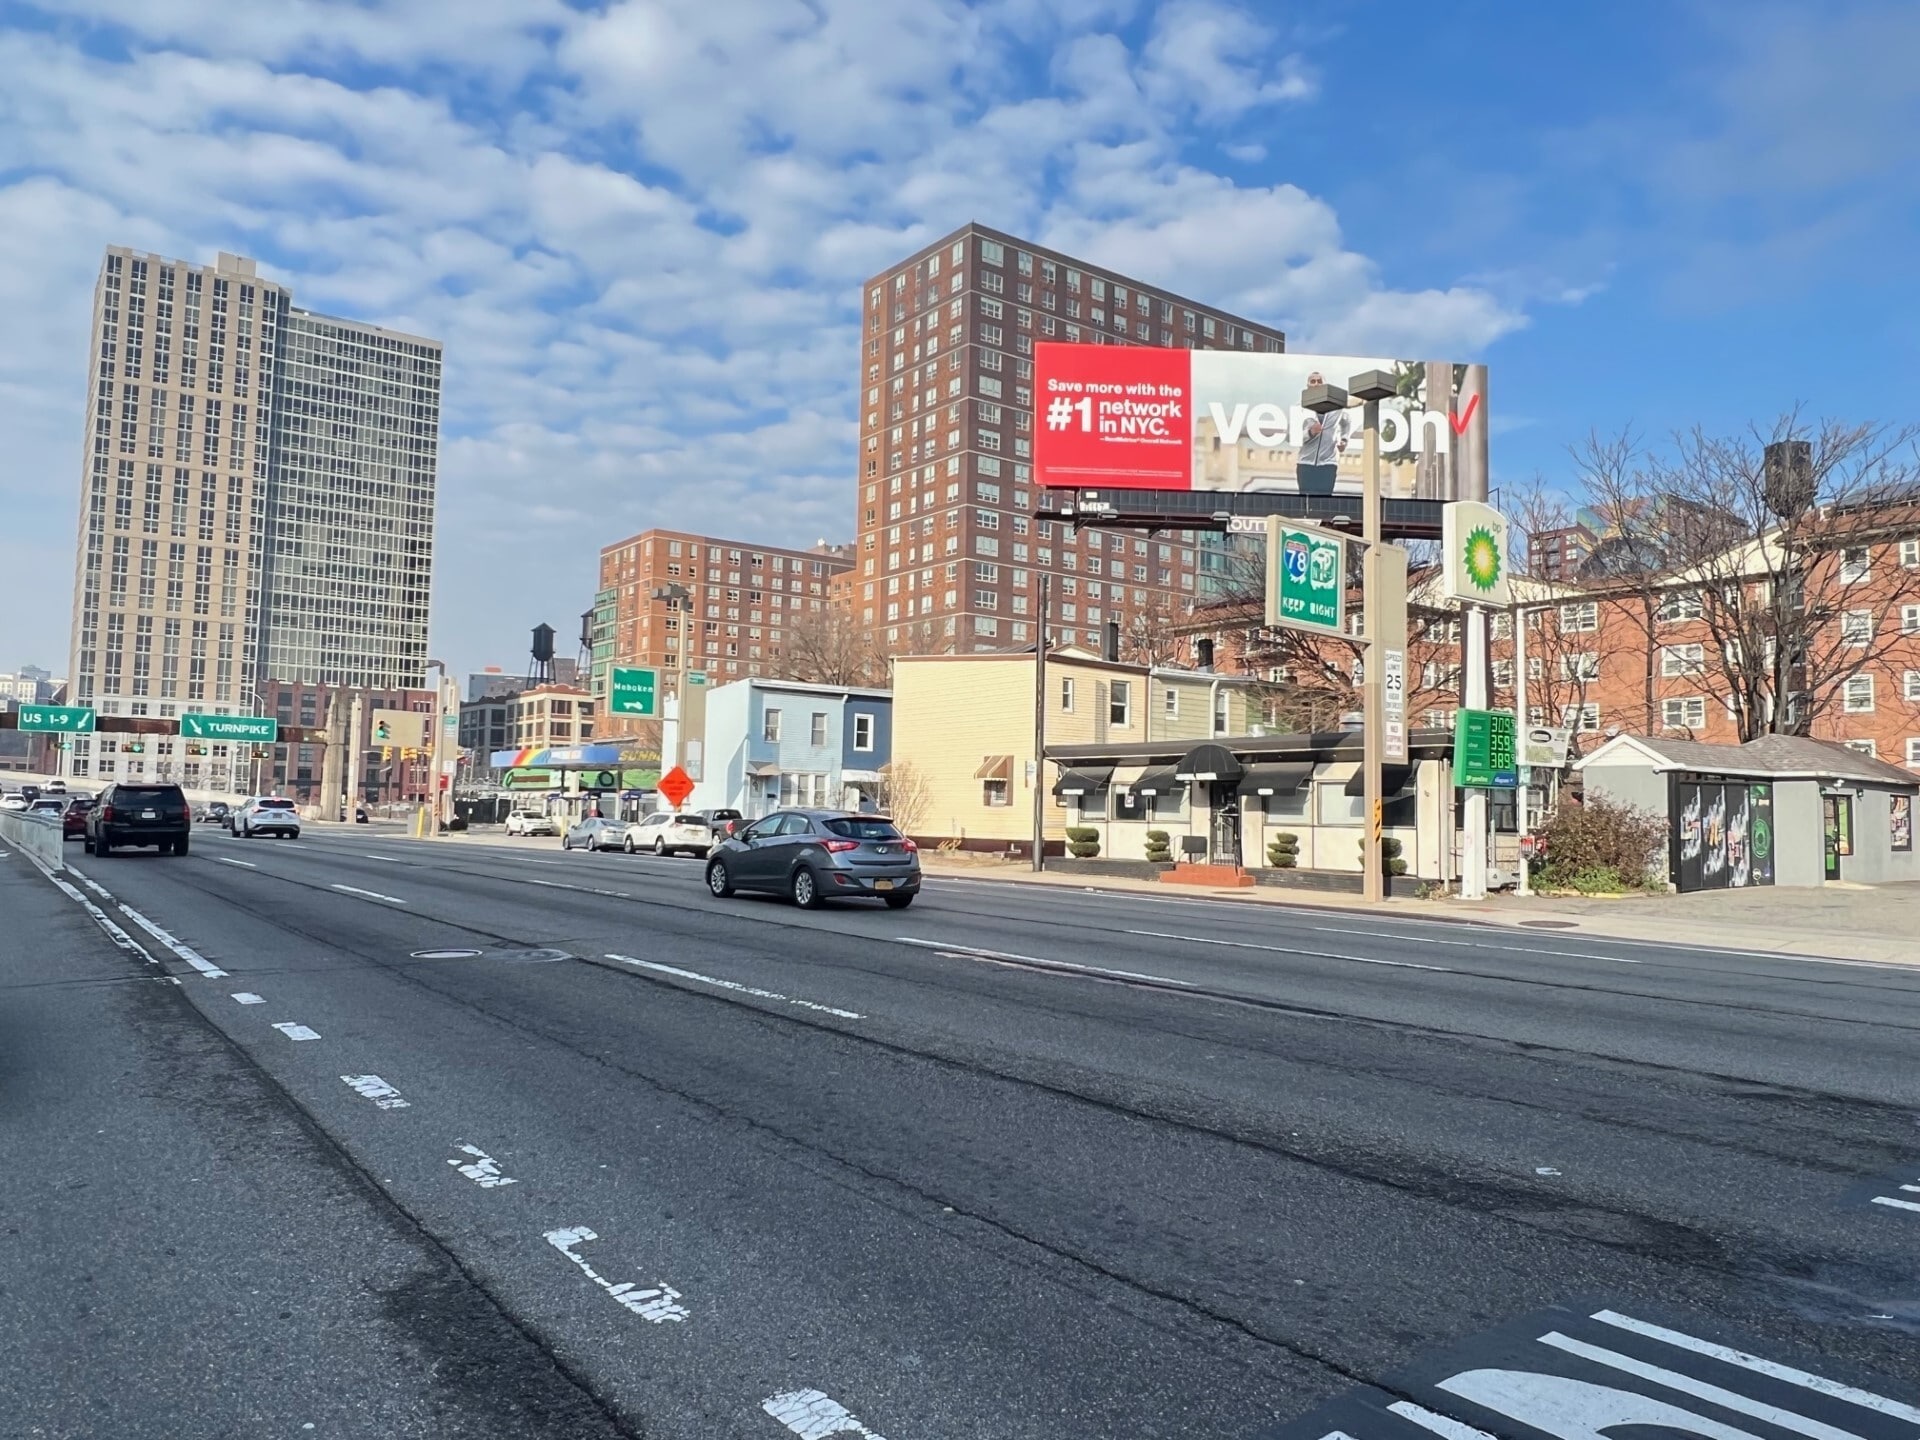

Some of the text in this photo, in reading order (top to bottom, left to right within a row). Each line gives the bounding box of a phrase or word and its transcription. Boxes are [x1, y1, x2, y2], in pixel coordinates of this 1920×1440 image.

[1047, 378, 1182, 397] Save more with the
[1046, 396, 1092, 433] #1
[1099, 399, 1182, 418] network
[1099, 415, 1169, 436] in NYC.
[1492, 520, 1502, 534] bp
[1286, 549, 1306, 572] 78
[1282, 597, 1335, 618] KEEP RIGHT
[1386, 674, 1402, 690] 25
[23, 713, 69, 725] US 1-9
[208, 722, 270, 735] TURNPIKE
